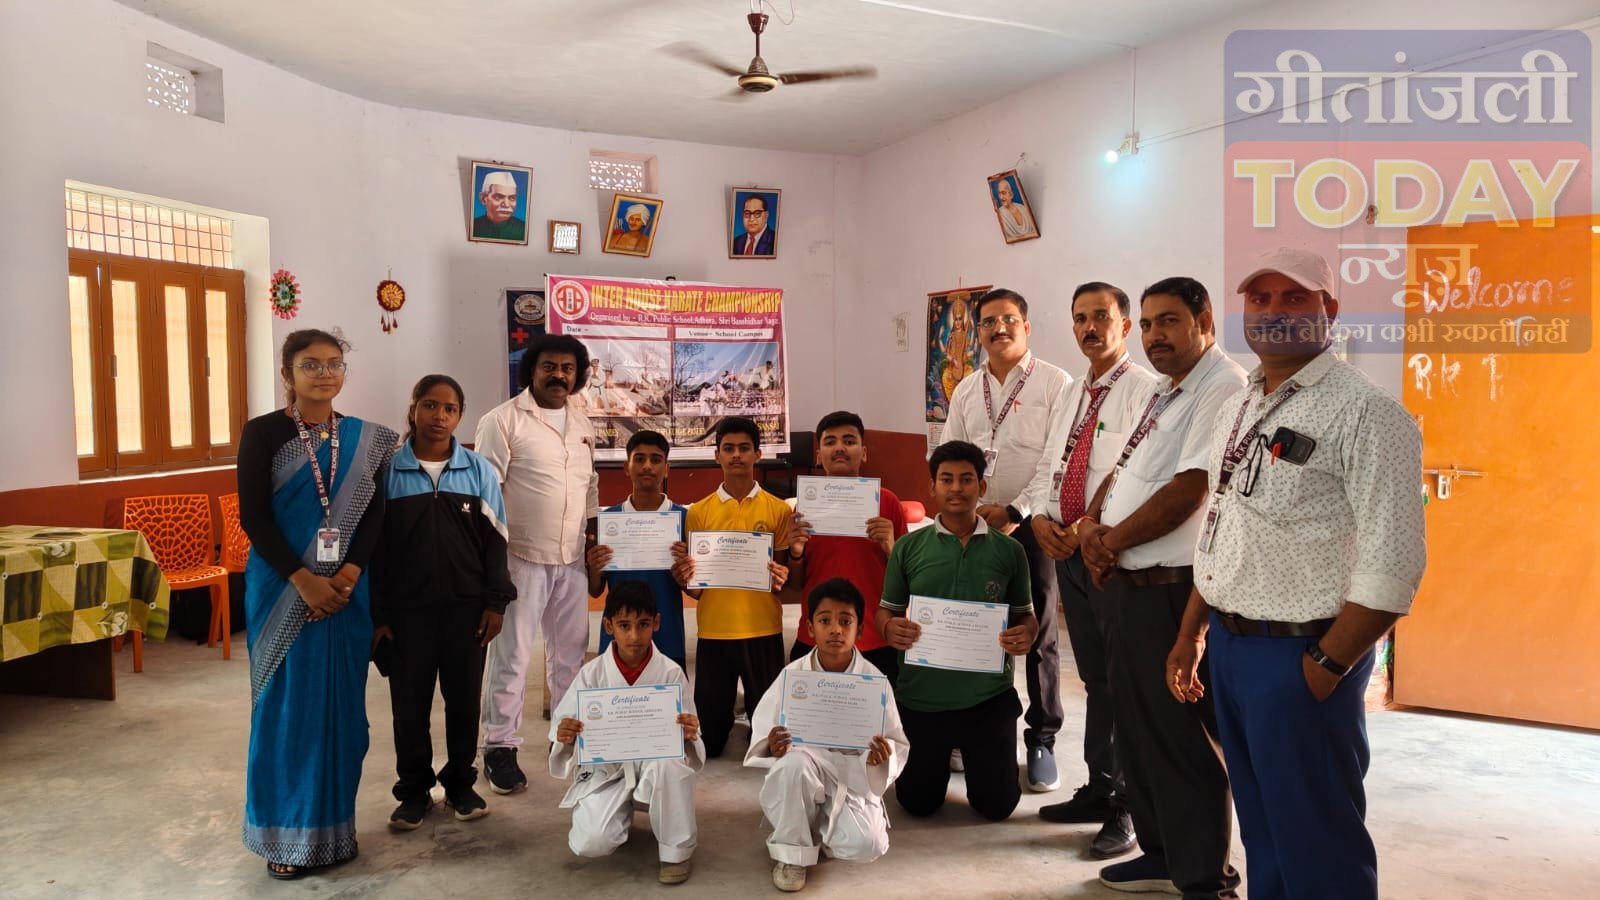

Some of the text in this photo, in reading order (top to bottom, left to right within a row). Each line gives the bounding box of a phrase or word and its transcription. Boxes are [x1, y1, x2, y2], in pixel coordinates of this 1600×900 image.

[1423, 257, 1574, 314] Welcome
[591, 284, 623, 309] INTER
[626, 286, 662, 312] HOUSE
[664, 289, 703, 312] KARATE
[704, 290, 782, 314] CHAMPIONSHIP
[823, 482, 856, 492] Certificate
[625, 518, 657, 527] Certificate
[716, 536, 748, 545] Certificate
[942, 606, 980, 618] Certificate
[817, 678, 857, 690] Certificate
[611, 695, 650, 706] Certificate
